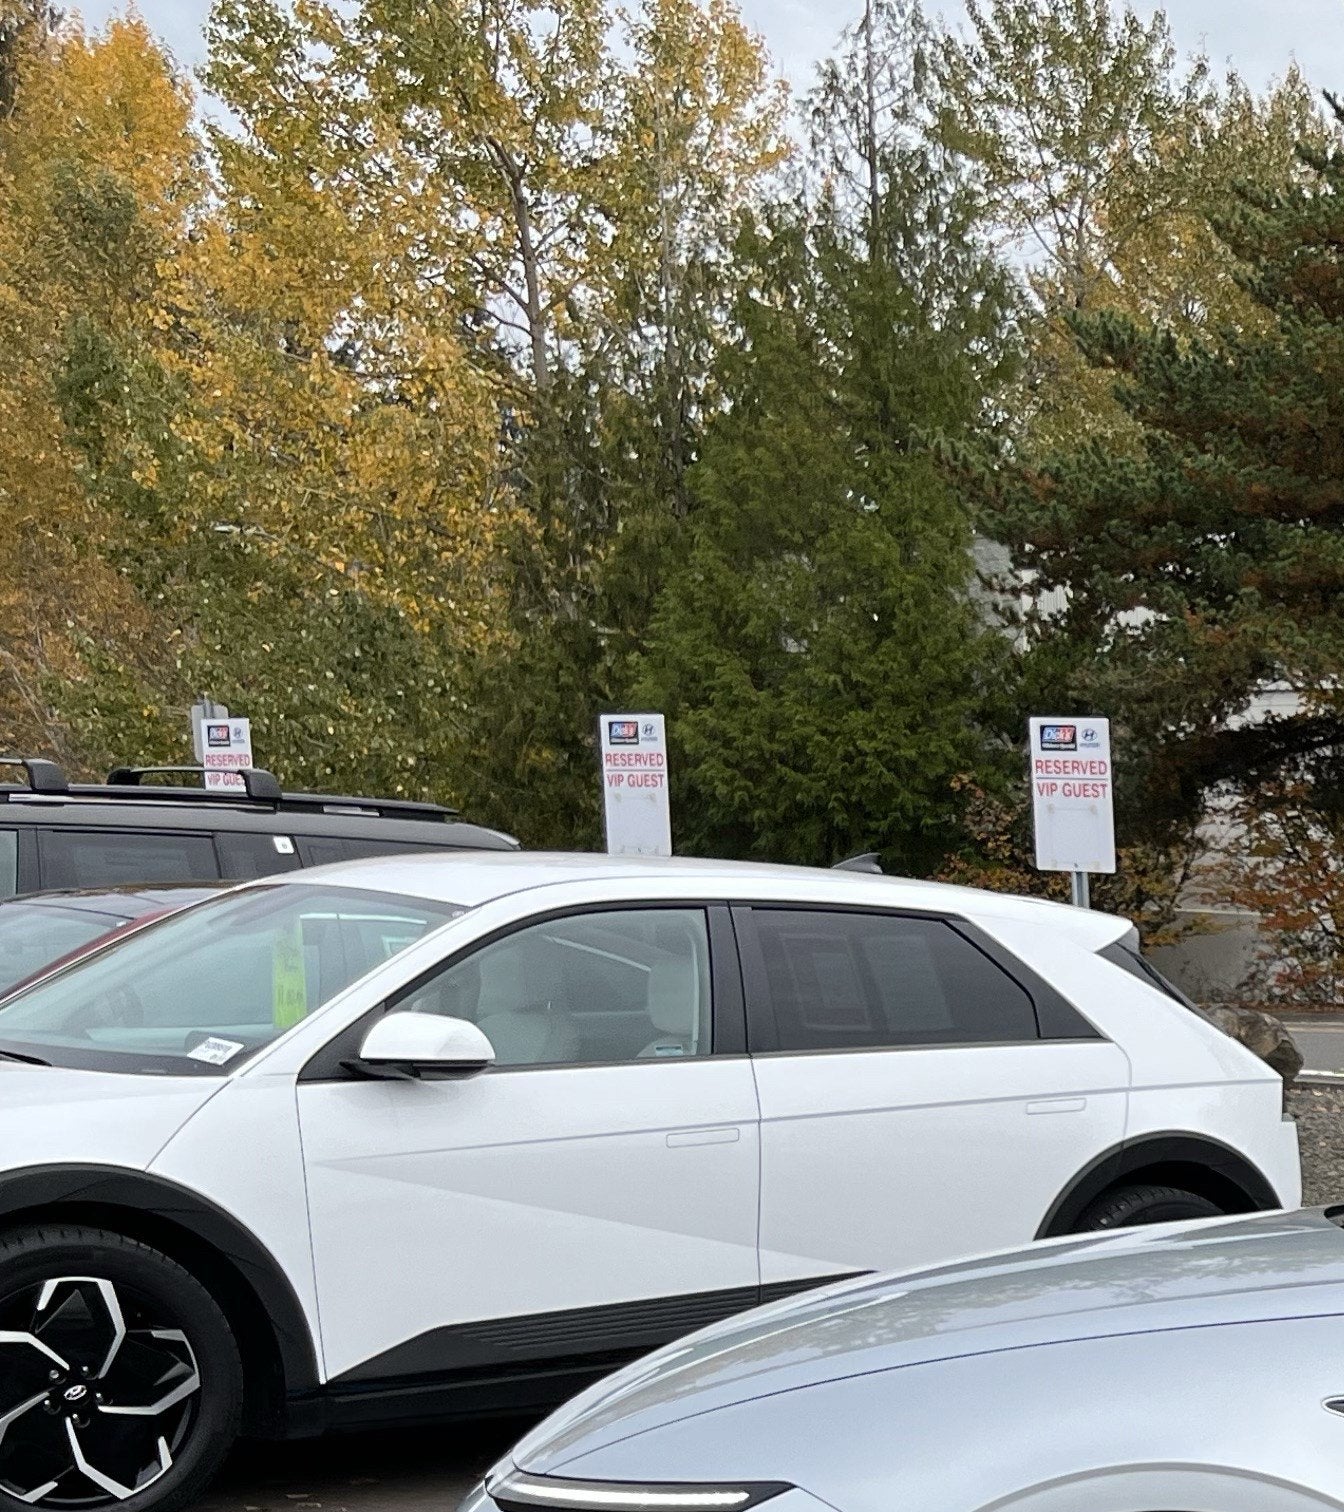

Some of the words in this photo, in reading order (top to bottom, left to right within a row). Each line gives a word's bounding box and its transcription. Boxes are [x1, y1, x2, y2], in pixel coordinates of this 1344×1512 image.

[206, 754, 250, 767] RESERVED
[605, 752, 664, 767] RESERVED
[1035, 759, 1108, 775] RESERVED
[207, 774, 220, 786] VIP
[607, 774, 624, 788] VIP
[628, 773, 665, 788] GUEST
[1037, 782, 1058, 797] VIP
[1062, 782, 1108, 798] GUEST
